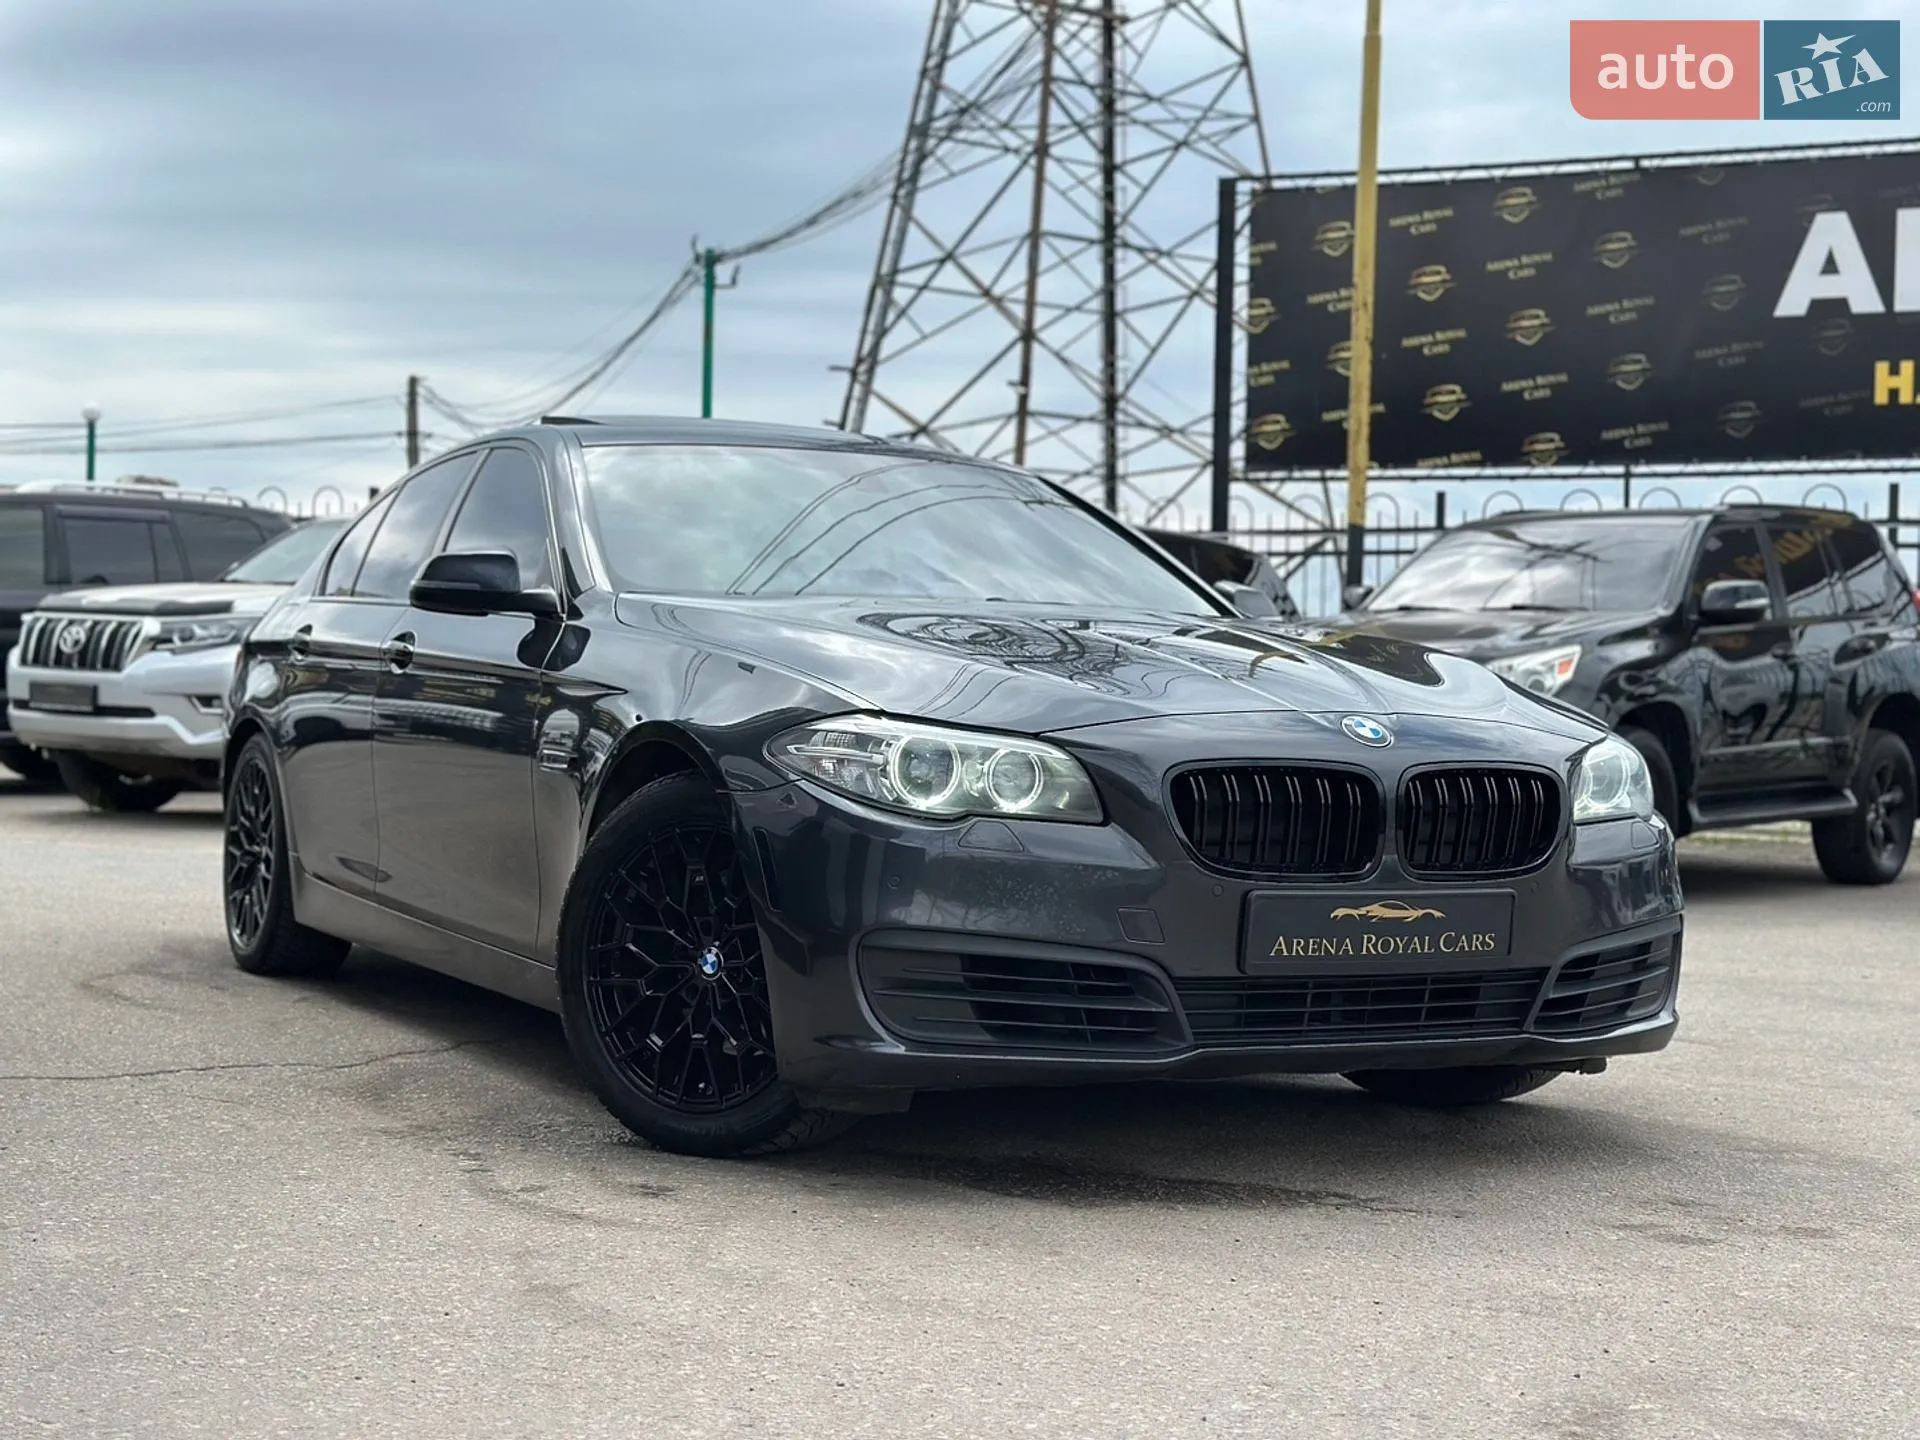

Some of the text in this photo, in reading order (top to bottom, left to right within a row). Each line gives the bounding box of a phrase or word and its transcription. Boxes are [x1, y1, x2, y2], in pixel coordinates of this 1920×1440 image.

[1270, 931, 1496, 956] ARENA ROYAL CARS
